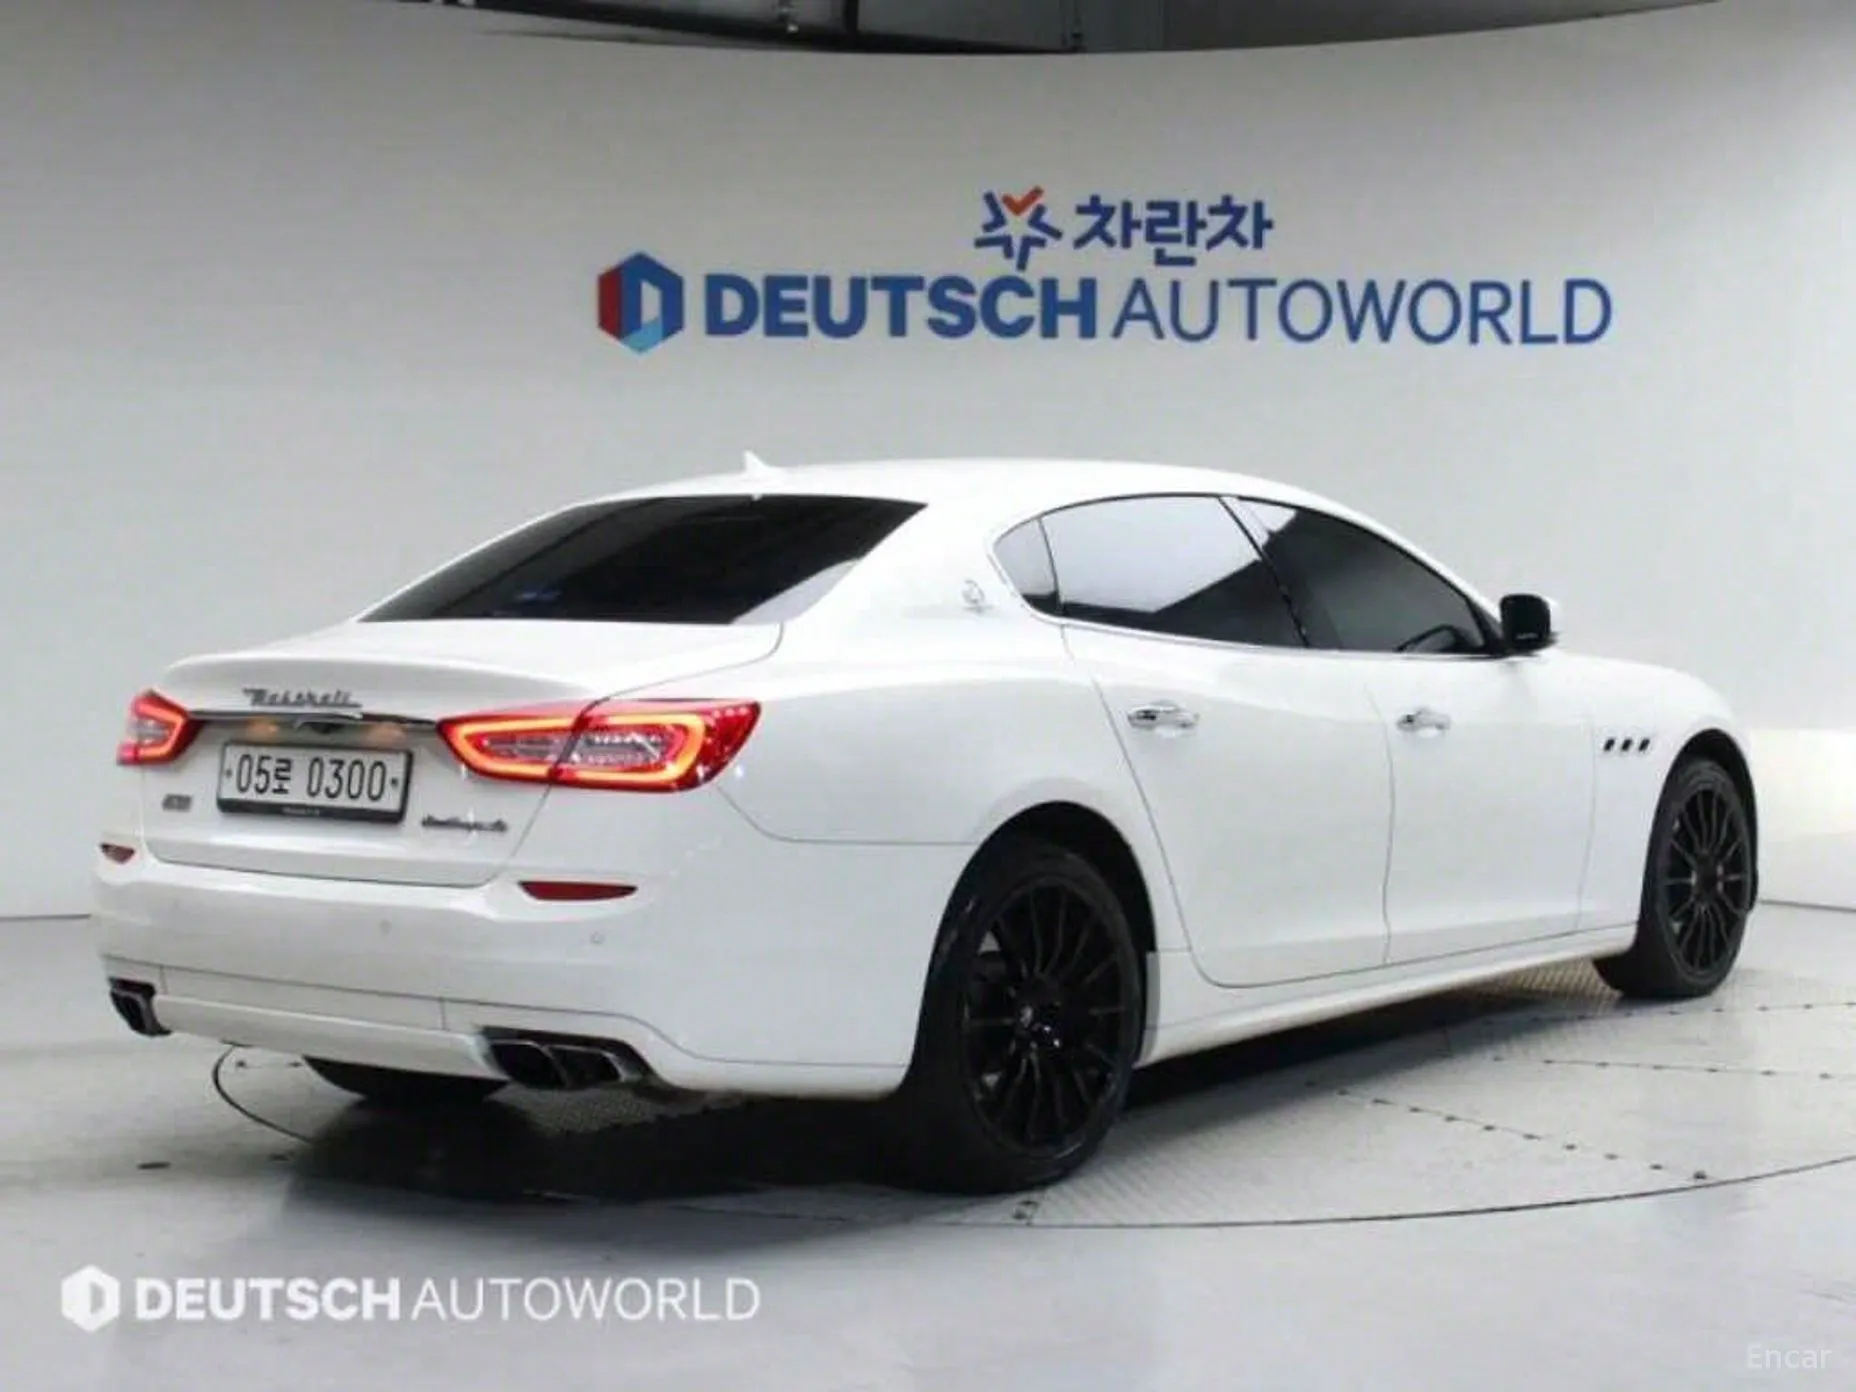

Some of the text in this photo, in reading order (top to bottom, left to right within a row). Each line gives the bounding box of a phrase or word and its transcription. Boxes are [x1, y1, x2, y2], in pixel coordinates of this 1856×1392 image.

[1072, 194, 1274, 267] 차란차
[705, 275, 1612, 345] DEUTSCH AUTOWORLD
[236, 754, 387, 801] 05로 0300
